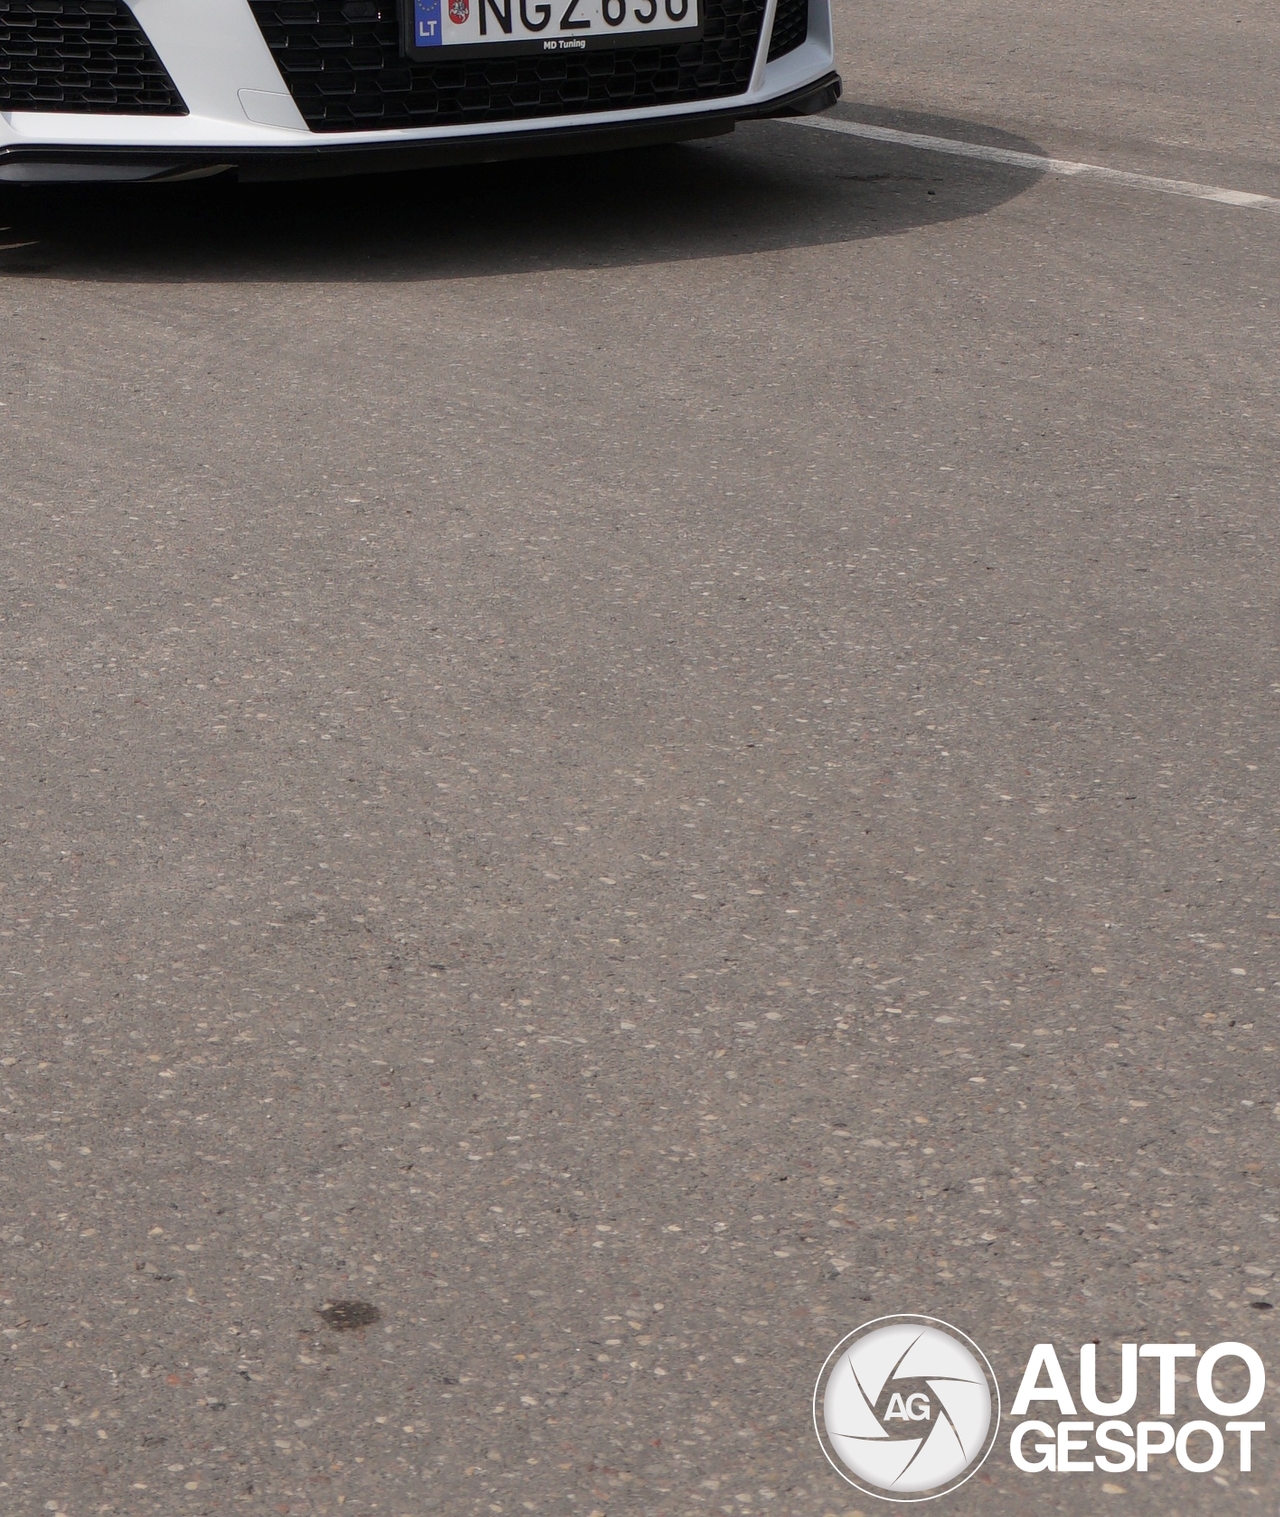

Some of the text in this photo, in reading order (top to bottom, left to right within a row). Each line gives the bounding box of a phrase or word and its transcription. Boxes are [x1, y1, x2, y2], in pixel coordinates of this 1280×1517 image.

[419, 20, 437, 37] LT
[543, 39, 586, 50] MD Tuning
